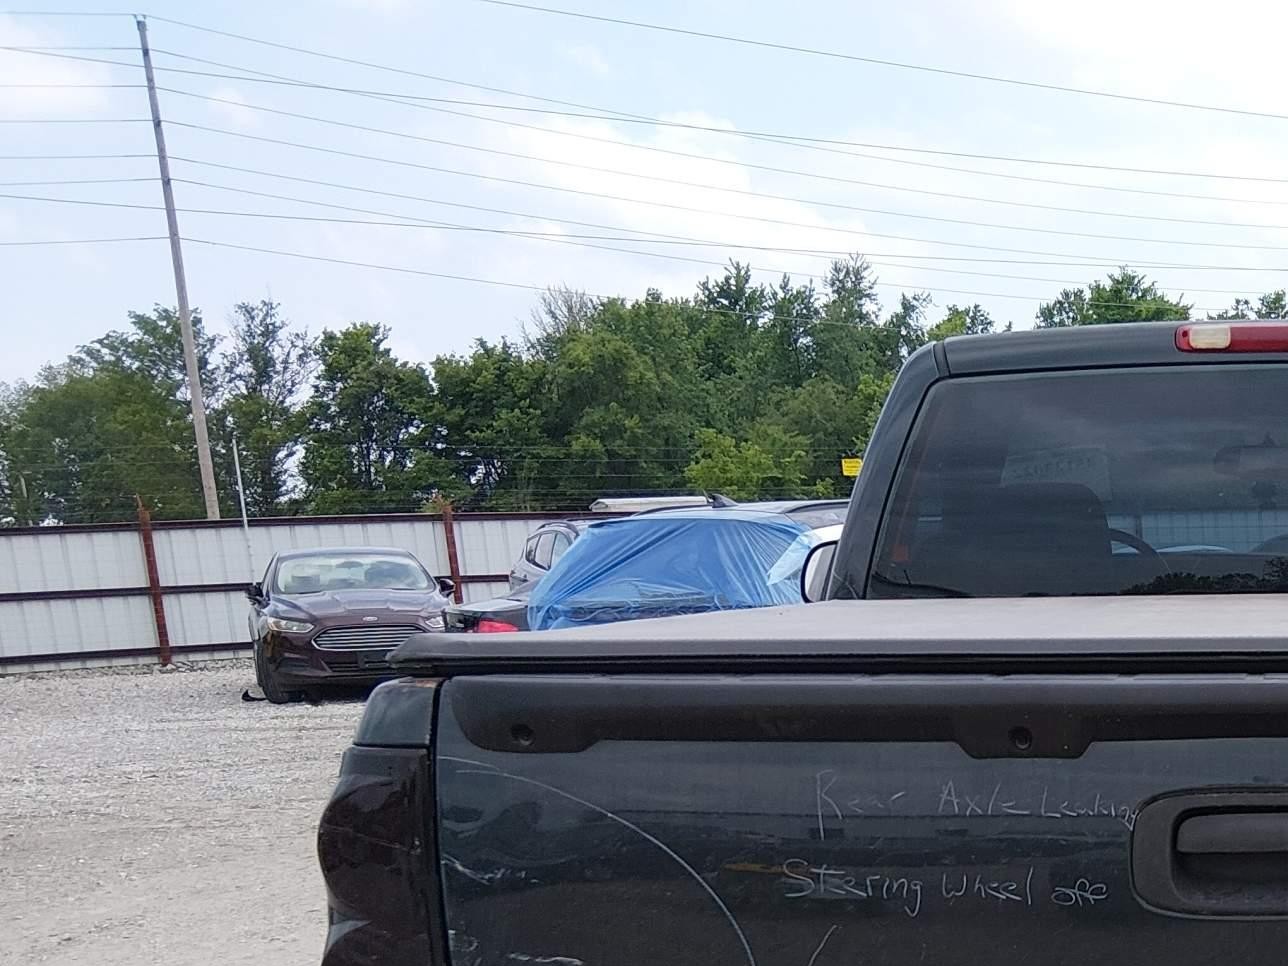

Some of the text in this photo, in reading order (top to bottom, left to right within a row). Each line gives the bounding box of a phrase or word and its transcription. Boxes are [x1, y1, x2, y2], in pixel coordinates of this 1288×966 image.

[936, 780, 1029, 815] Axle
[941, 865, 1034, 905] Wheel
[1050, 877, 1108, 905] off
